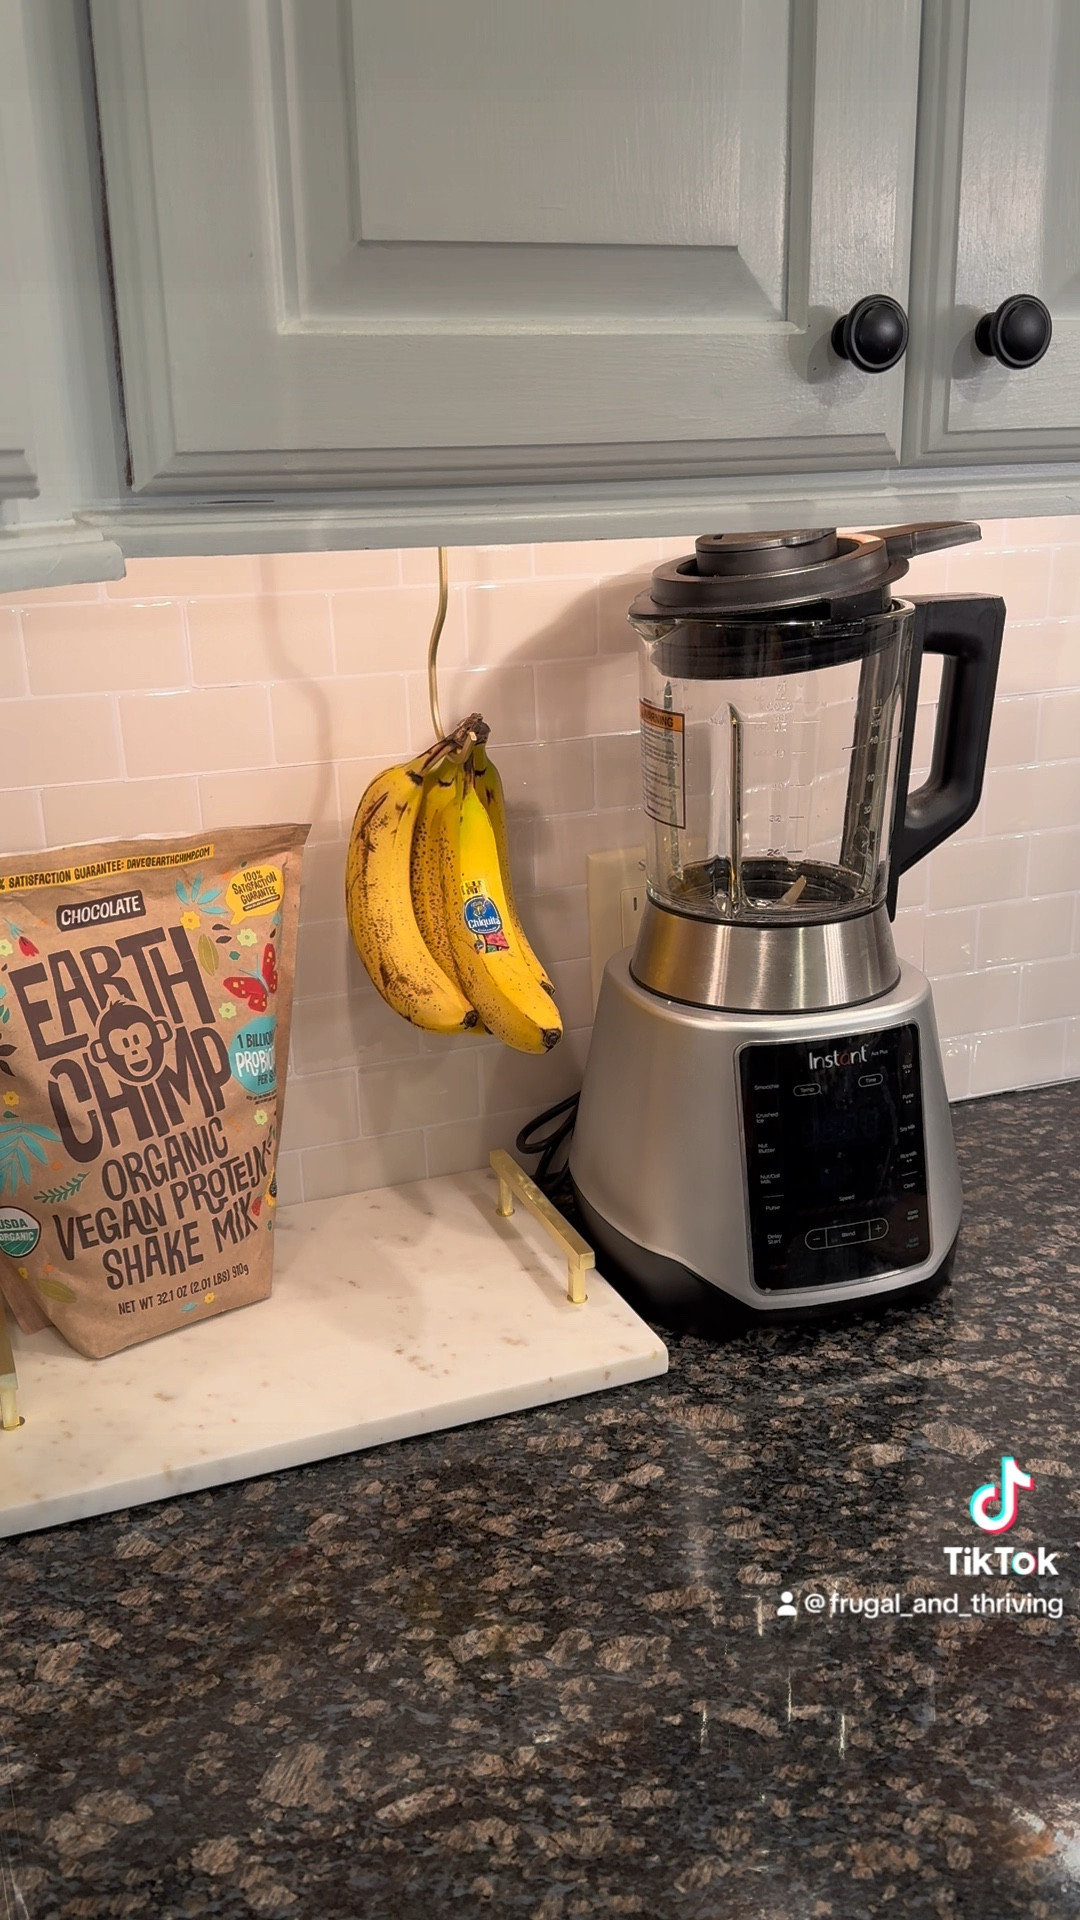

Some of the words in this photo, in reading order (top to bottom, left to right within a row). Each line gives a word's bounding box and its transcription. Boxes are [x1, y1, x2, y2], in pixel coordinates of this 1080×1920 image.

[9, 869, 72, 889] SATISFACTION
[74, 860, 125, 881] GUARANTEE:
[242, 869, 263, 883] 100%
[60, 895, 141, 926] CHOCOLATE
[240, 885, 277, 905] GUARANTEE
[467, 916, 501, 930] Chiquita
[9, 925, 216, 1061] EARTH
[236, 1033, 244, 1049] 1
[808, 1045, 868, 1070] Instant
[48, 1026, 231, 1163] CHIMP
[102, 1117, 229, 1202] ORGANIC
[52, 1192, 167, 1261] VEGAN
[170, 1140, 272, 1220] PROTEIN
[102, 1221, 204, 1290] SHAKE
[211, 1191, 258, 1254] MIX
[118, 1300, 136, 1315] NET
[139, 1296, 154, 1311] WT
[156, 1290, 174, 1306] 32.1
[176, 1285, 188, 1299] OZ
[190, 1276, 212, 1295] (2.01
[213, 1269, 230, 1287] LBS)
